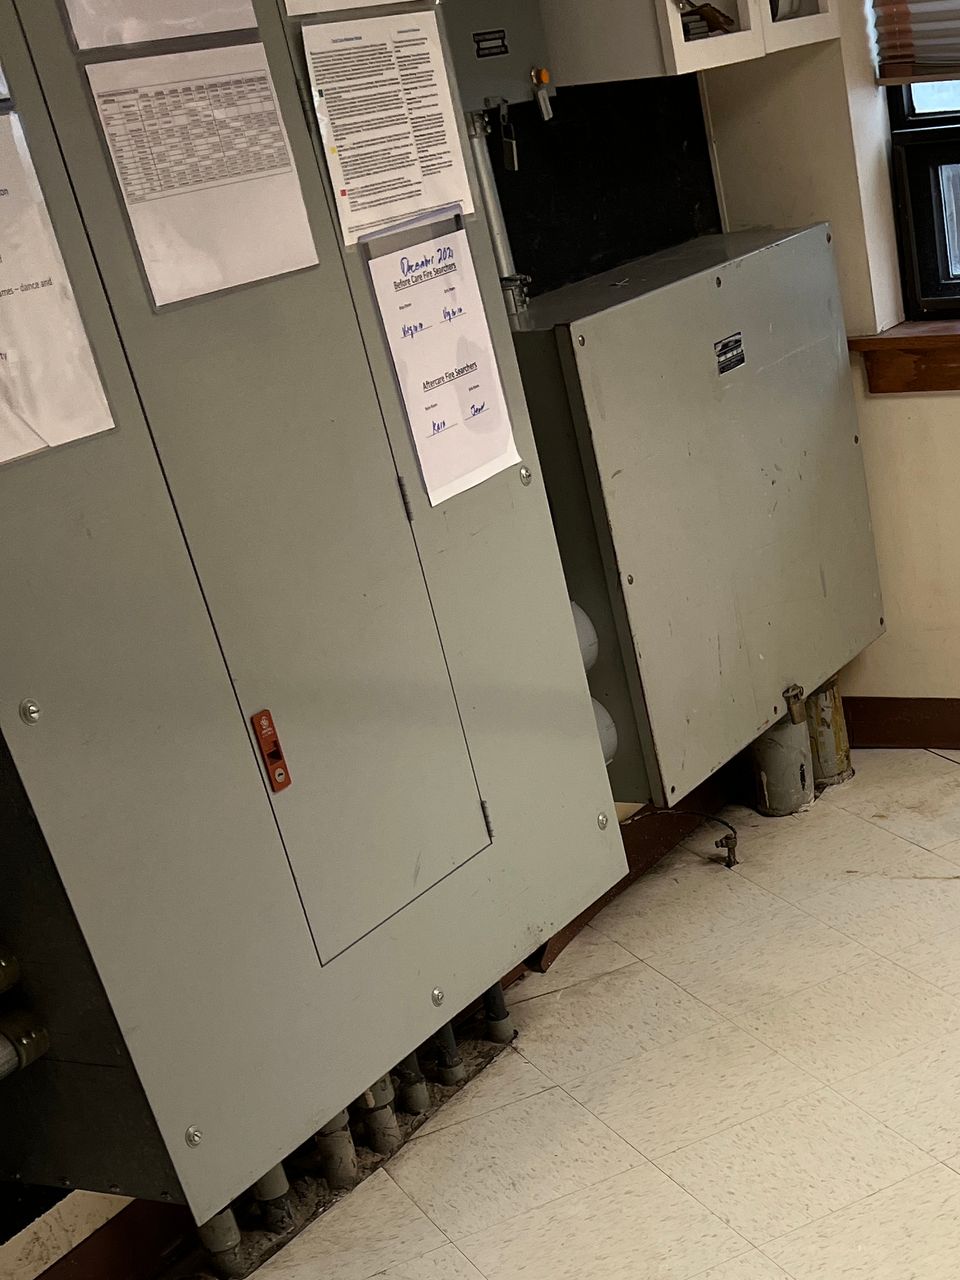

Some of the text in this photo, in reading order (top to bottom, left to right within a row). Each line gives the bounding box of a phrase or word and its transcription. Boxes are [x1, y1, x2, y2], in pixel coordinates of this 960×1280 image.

[20, 280, 39, 292] dance
[41, 277, 52, 288] and
[393, 262, 457, 290] Before Care Fire Searchers
[422, 361, 478, 391] Aftercare Fire Searchers
